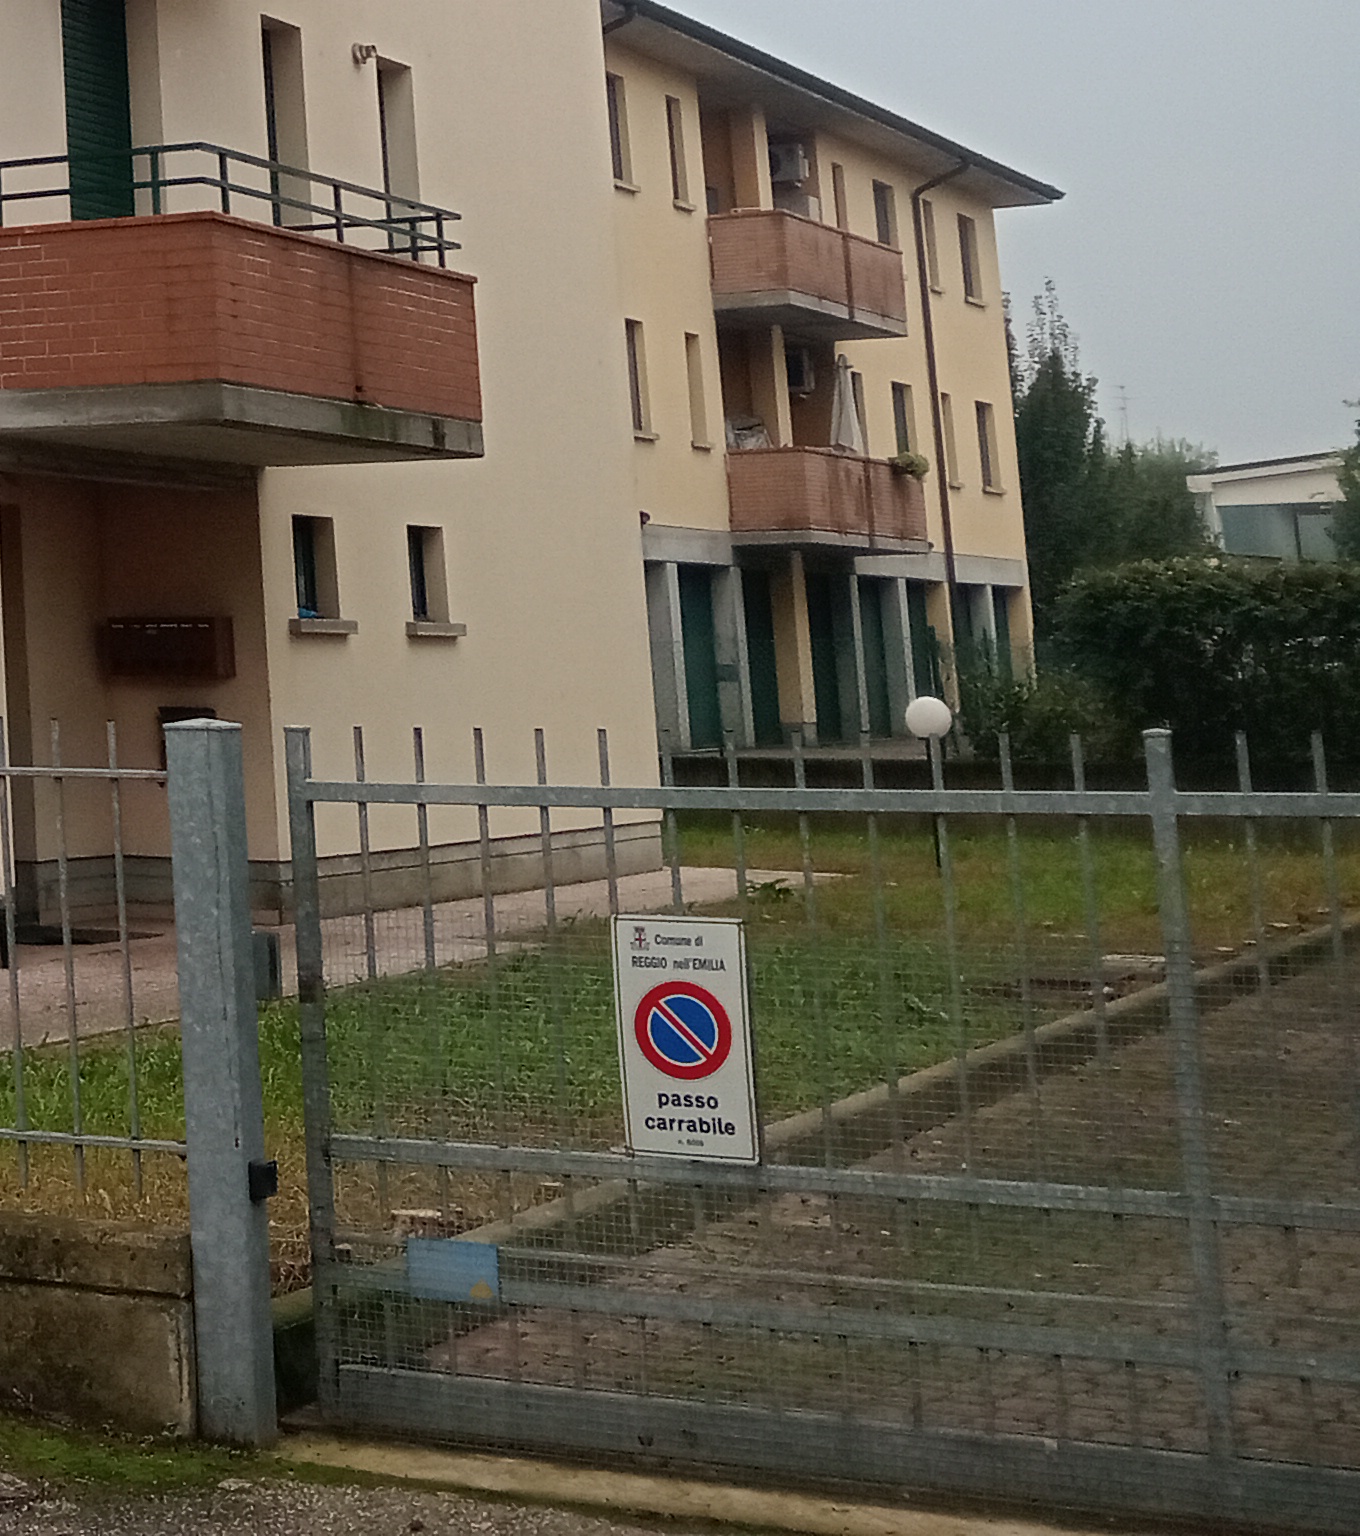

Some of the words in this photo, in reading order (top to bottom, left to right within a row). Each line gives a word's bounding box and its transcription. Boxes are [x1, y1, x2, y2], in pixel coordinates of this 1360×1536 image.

[654, 934, 692, 946] Comune
[694, 935, 703, 947] di
[631, 955, 668, 969] REGGIO
[657, 1092, 719, 1110] passo
[644, 1116, 736, 1136] carrabile
